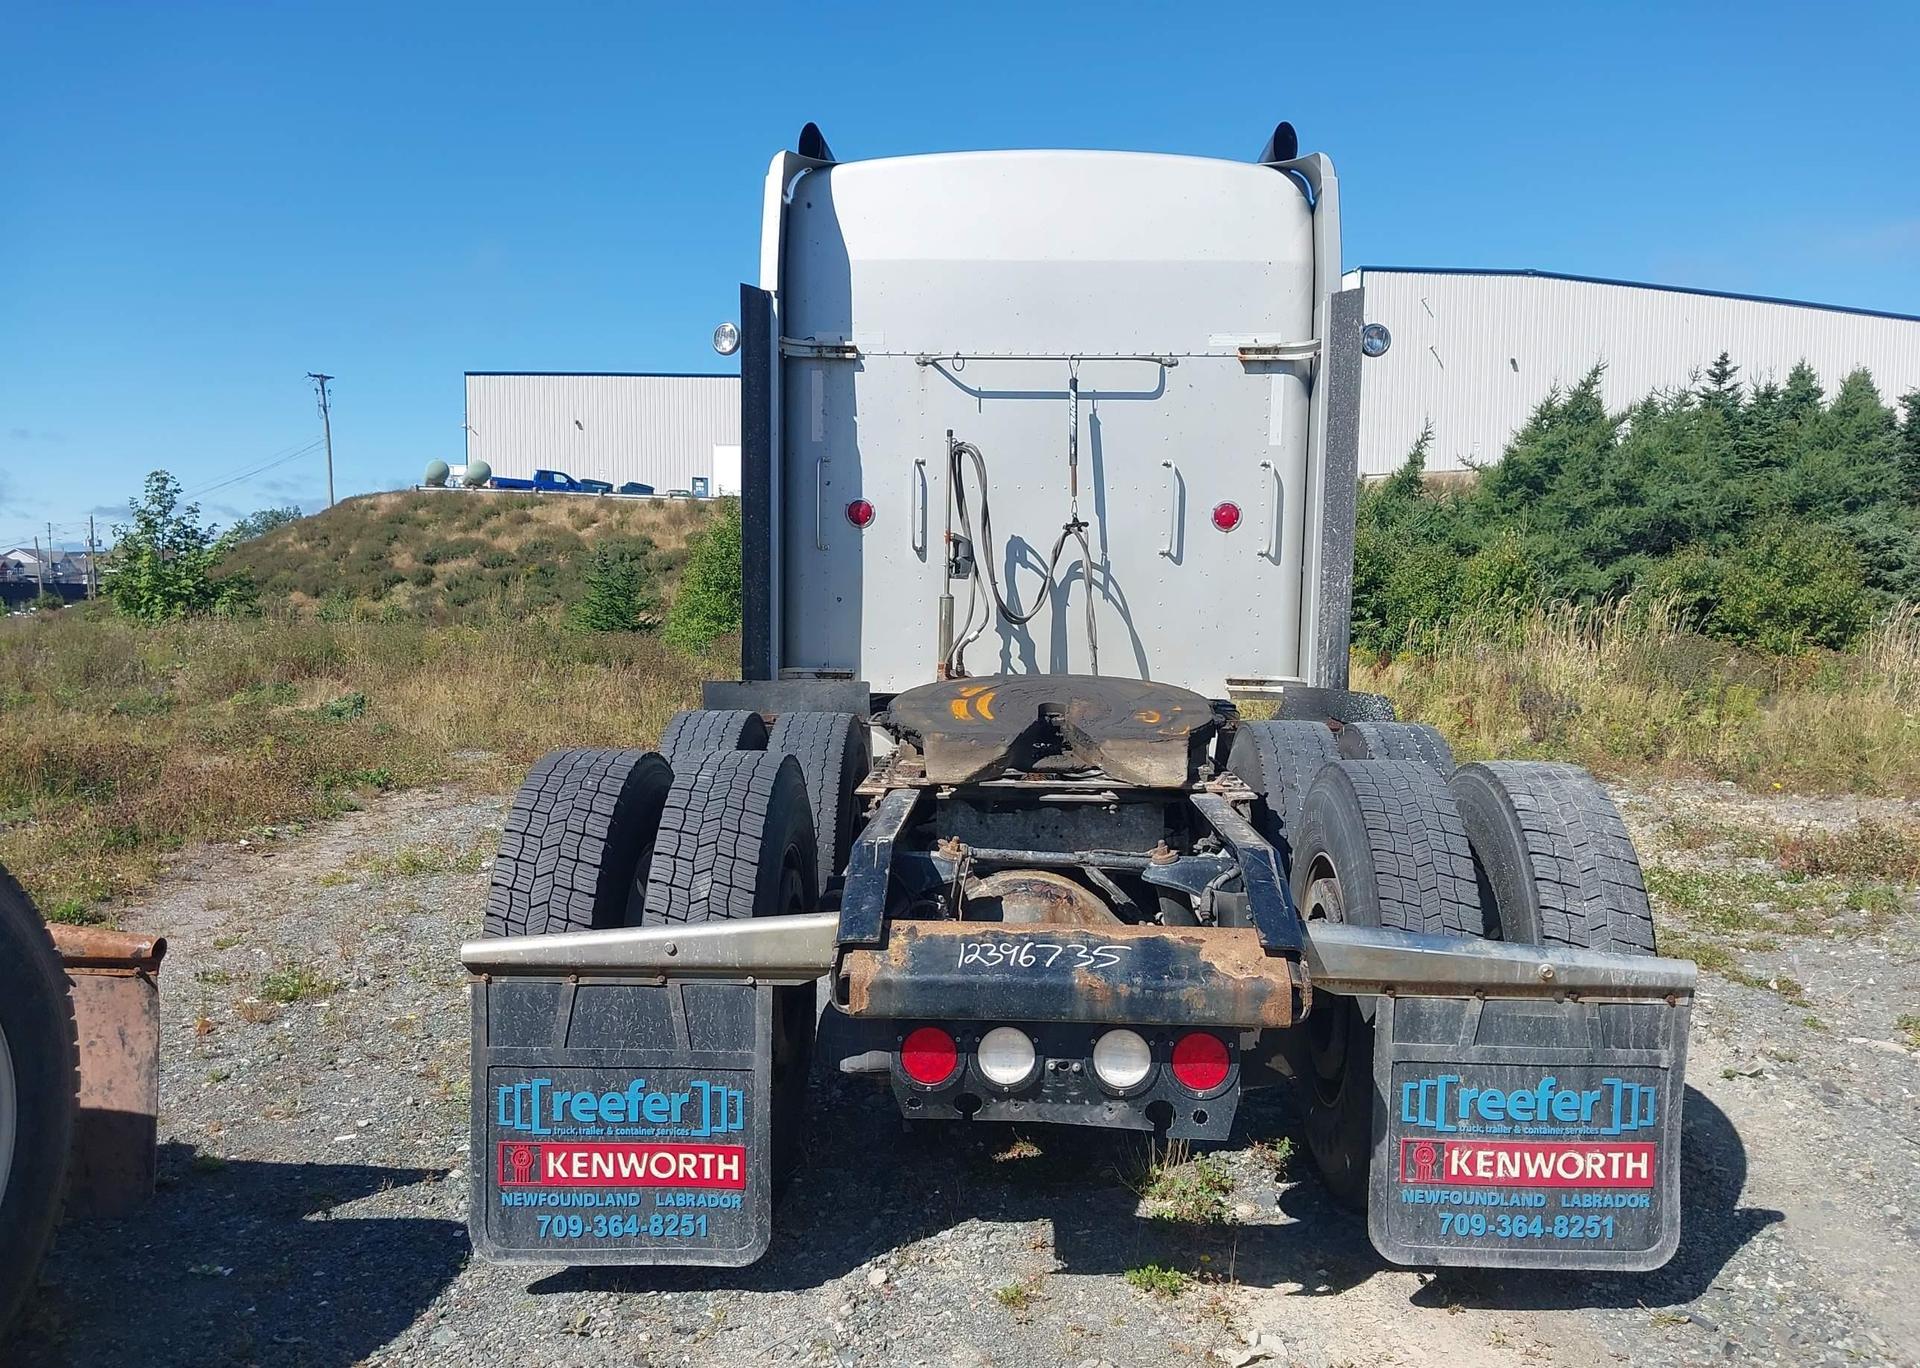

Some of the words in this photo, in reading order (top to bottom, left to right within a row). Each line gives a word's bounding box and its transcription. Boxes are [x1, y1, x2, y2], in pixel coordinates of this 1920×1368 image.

[957, 942, 1132, 969] 12396735
[552, 1078, 690, 1124] reefer
[1458, 1076, 1601, 1122] reefer
[606, 1126, 615, 1136] &
[547, 1151, 739, 1181] KENWORTH
[1450, 1149, 1649, 1180] KENWORTH
[501, 1192, 641, 1208] NEWFOUNDLAND
[656, 1193, 743, 1209] LABRADOR
[1402, 1189, 1546, 1208] NEWFOUNDLAND
[1561, 1193, 1650, 1209] LABRADOR
[537, 1214, 708, 1239] 709-364-8251
[1439, 1213, 1615, 1240] 709-364-8251
